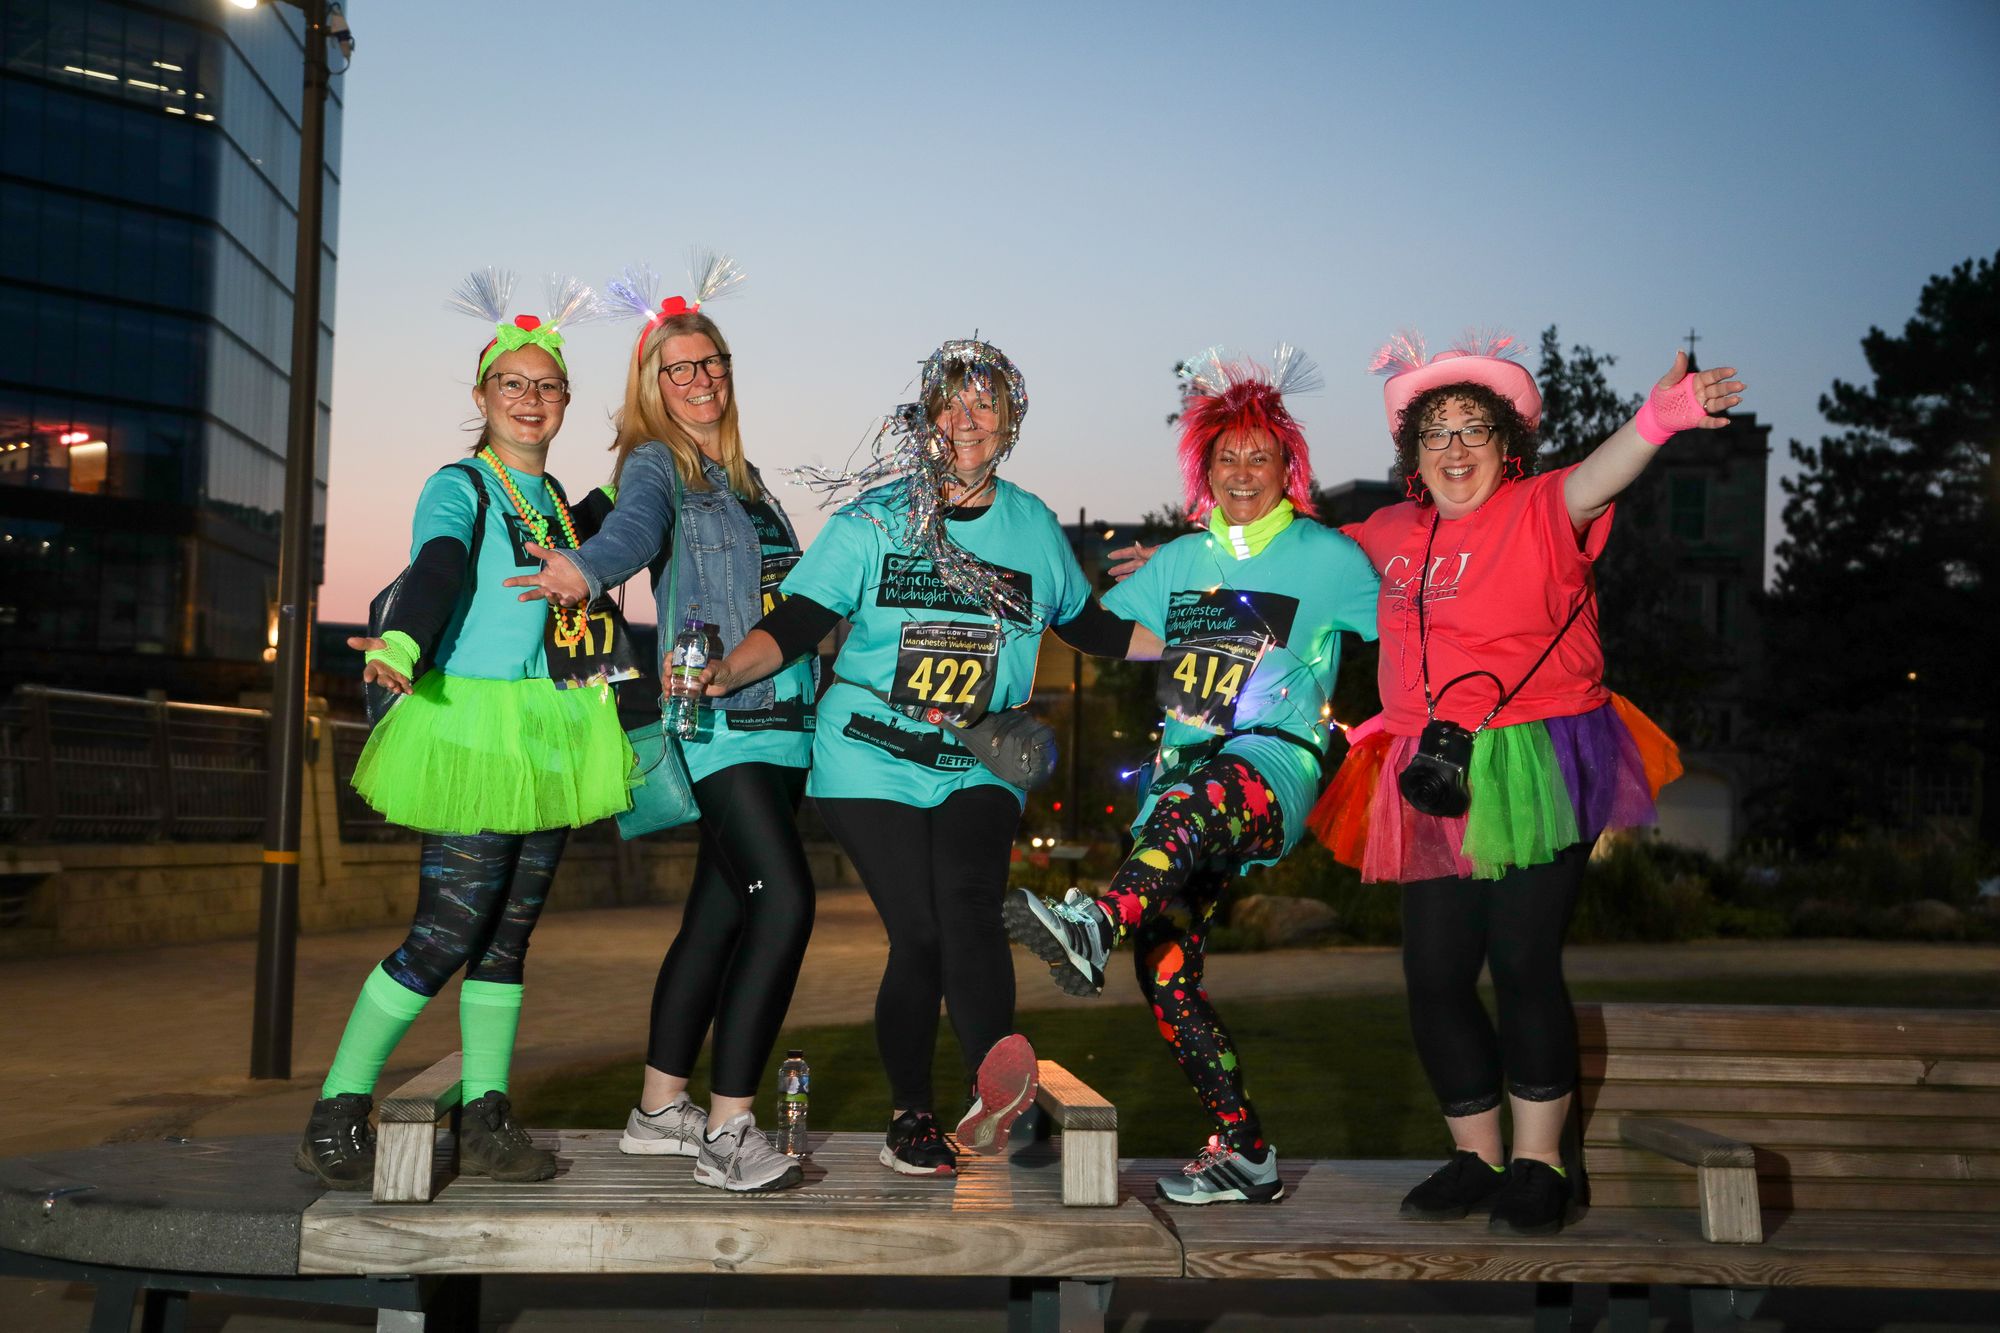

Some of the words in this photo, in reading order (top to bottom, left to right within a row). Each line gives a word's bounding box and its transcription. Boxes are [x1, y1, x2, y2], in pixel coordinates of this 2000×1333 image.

[554, 612, 614, 657] 417
[1169, 605, 1225, 618] anchester
[907, 656, 983, 704] 422
[1173, 652, 1244, 707] 414
